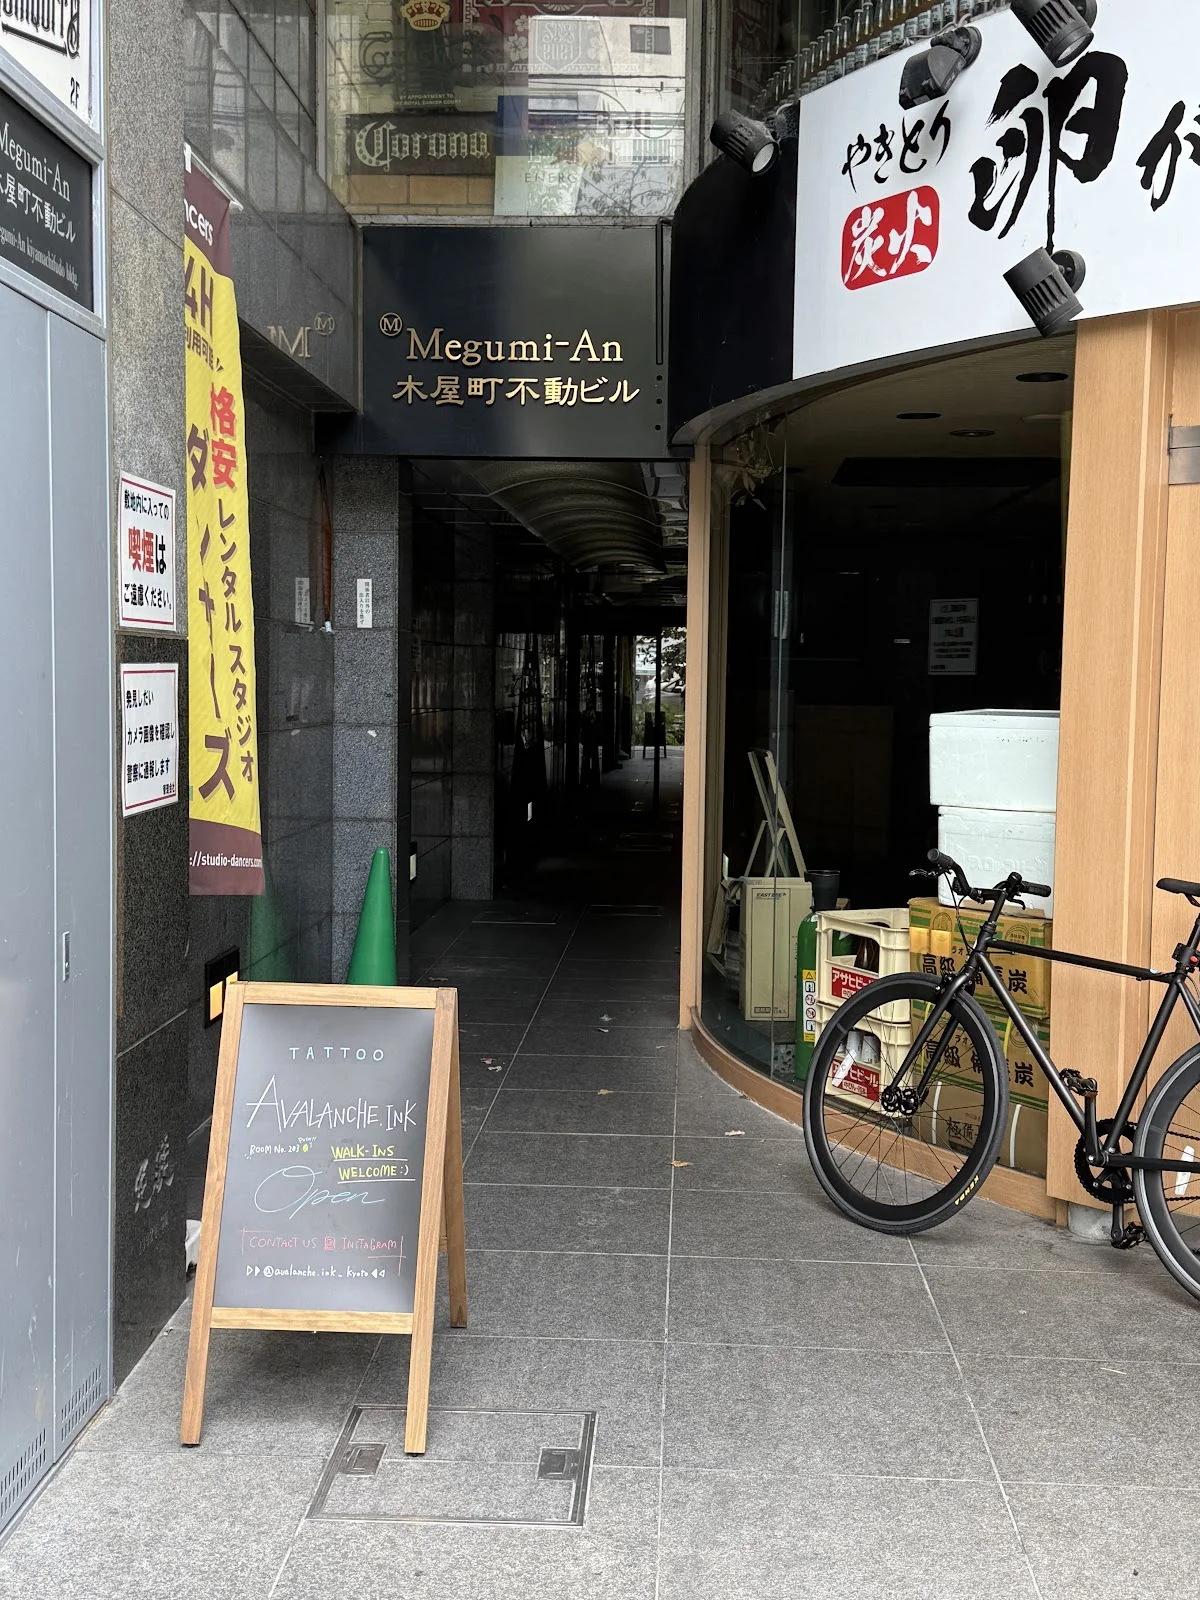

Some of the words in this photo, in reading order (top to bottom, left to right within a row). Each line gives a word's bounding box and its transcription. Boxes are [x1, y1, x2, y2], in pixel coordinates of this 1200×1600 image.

[70, 76, 80, 110] 2F
[354, 121, 490, 172] Corona
[842, 100, 951, 193] やきとり
[844, 191, 933, 284] 炭火
[405, 328, 624, 367] Megumi-An
[391, 374, 640, 407] 木屋町不動ビル
[128, 525, 167, 575] 喫煙は
[289, 1047, 384, 1061] TATTOO
[249, 1143, 272, 1155] ROOM
[254, 1165, 387, 1220] Open
[249, 1236, 299, 1249] CONTACT
[302, 1238, 318, 1249] US
[341, 1237, 397, 1251] INSTAGRAM
